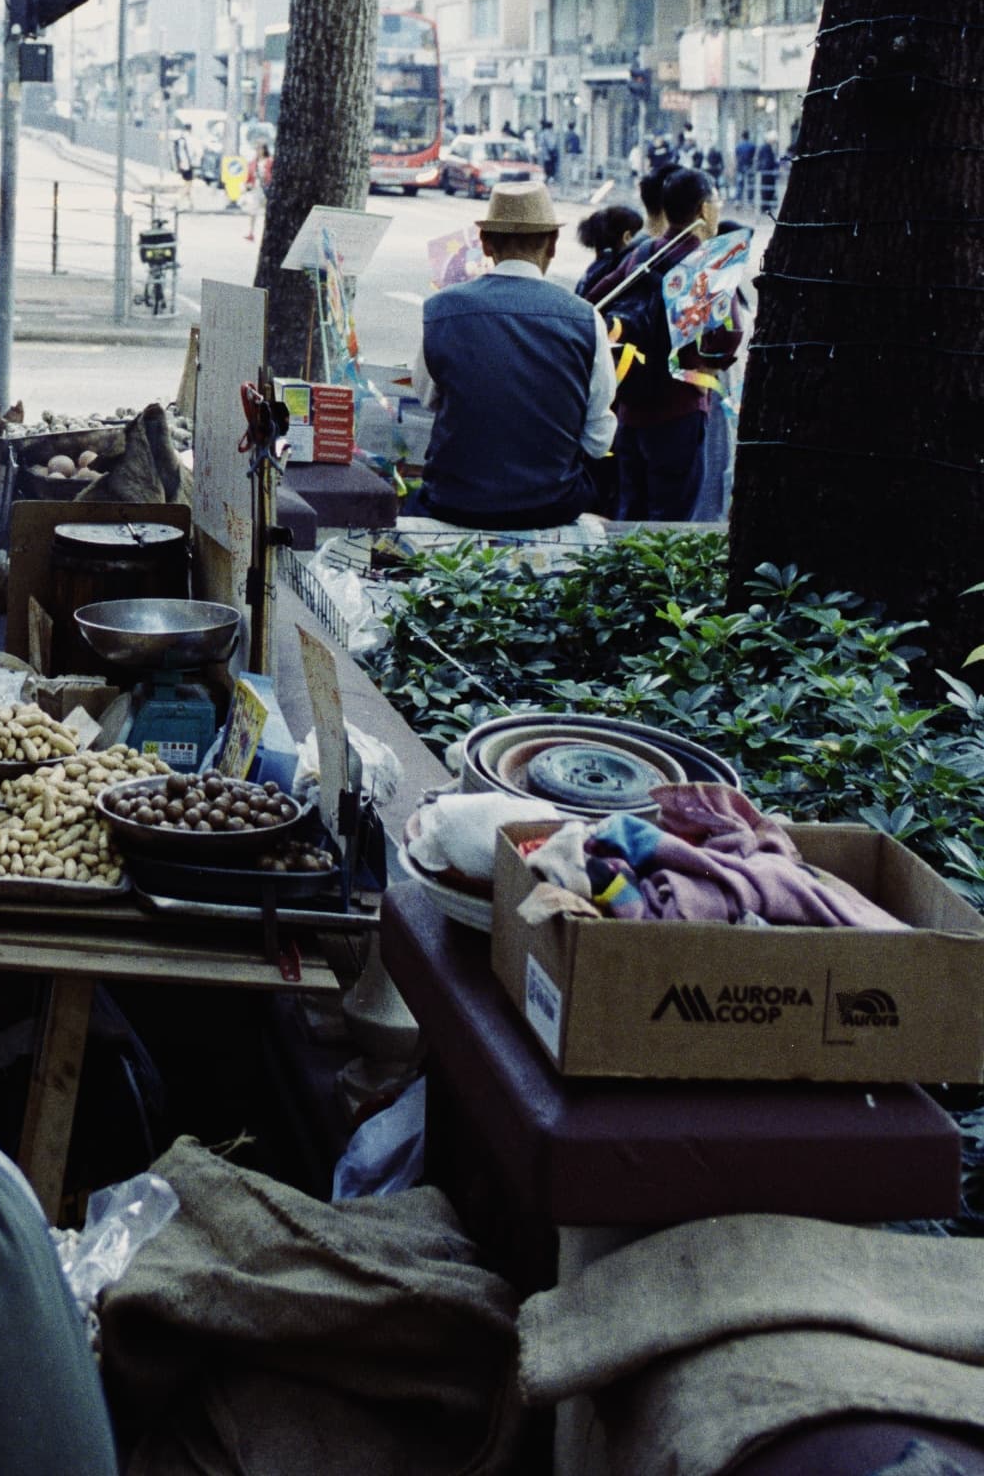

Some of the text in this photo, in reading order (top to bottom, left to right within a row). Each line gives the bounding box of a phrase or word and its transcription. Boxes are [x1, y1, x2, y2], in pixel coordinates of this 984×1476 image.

[717, 985, 813, 1006] AURORA
[716, 1005, 782, 1024] COOP
[841, 1012, 900, 1027] Aurora
